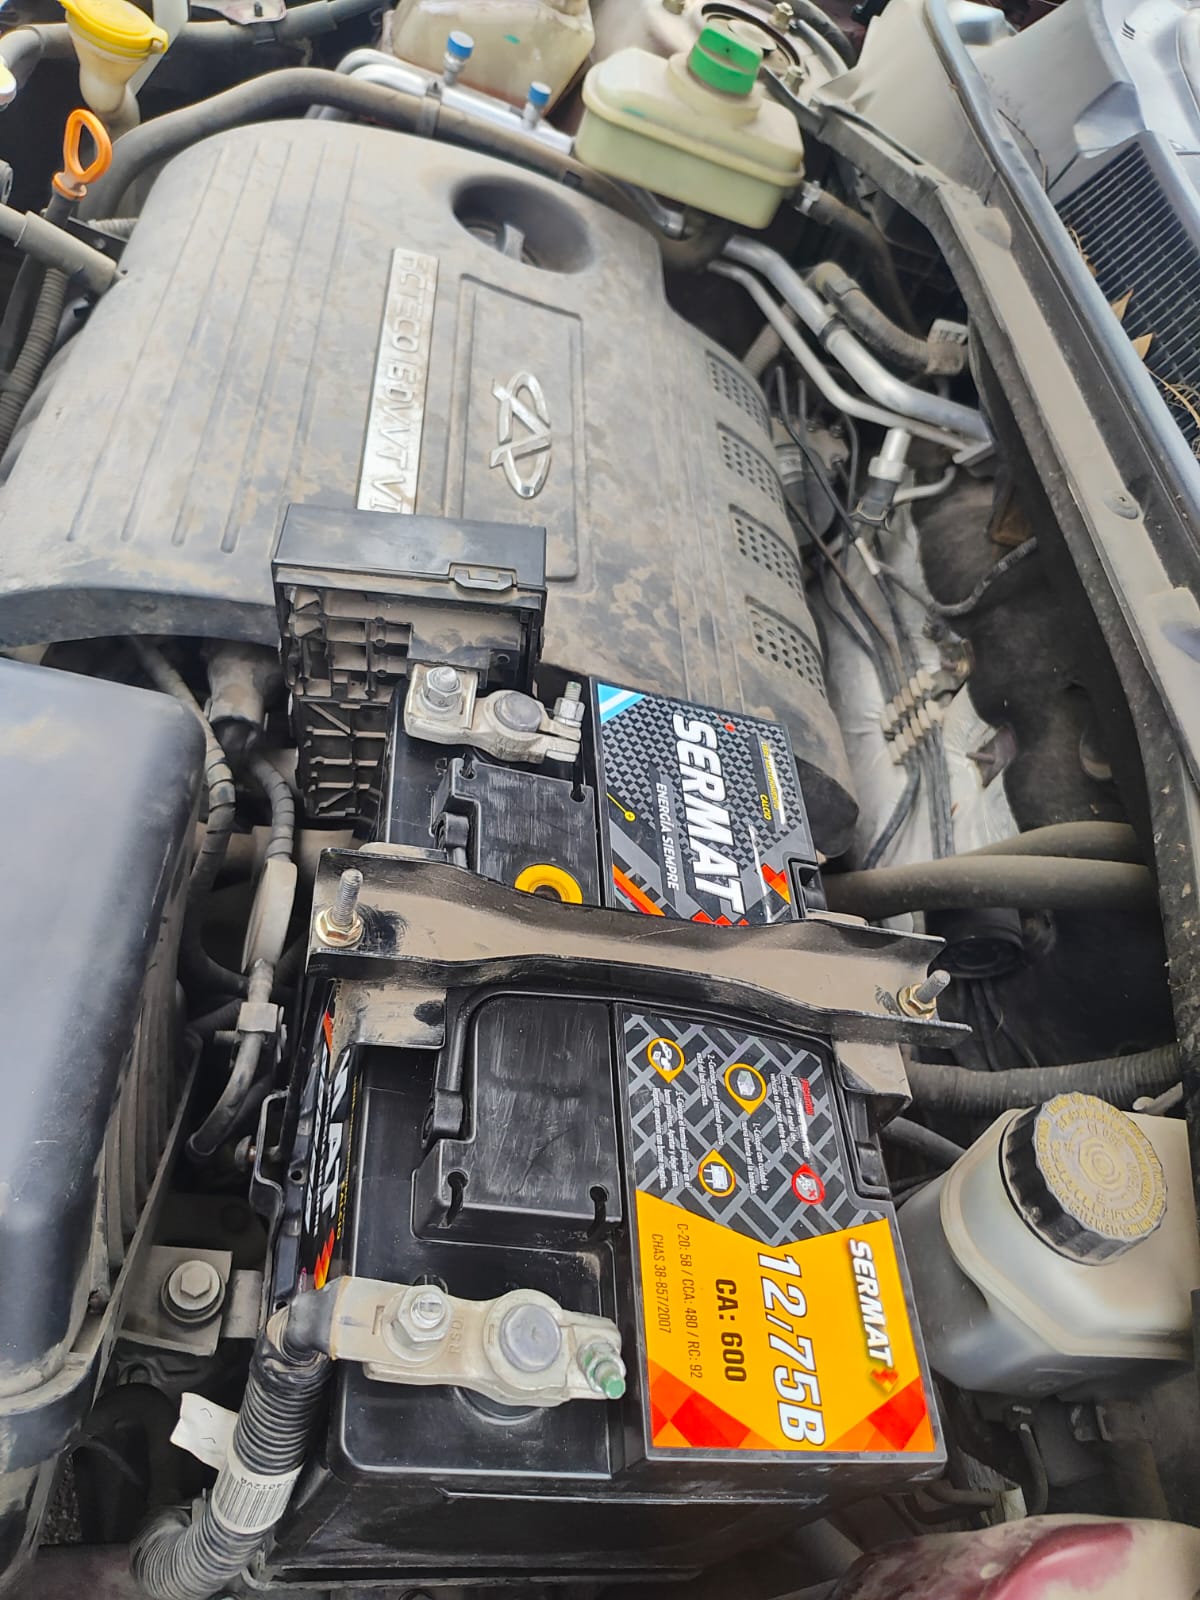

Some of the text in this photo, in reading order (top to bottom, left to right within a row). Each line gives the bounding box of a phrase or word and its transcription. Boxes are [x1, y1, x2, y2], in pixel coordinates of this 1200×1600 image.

[673, 713, 746, 915] SERMAT
[760, 794, 772, 820] CALCIO
[656, 783, 679, 891] ENERGÍA SIEMPRE
[677, 1223, 690, 1251] C-20:
[679, 1253, 692, 1267] 58
[652, 1233, 672, 1334] CHAS 38-857/2007
[681, 1278, 695, 1304] CCA:
[848, 1237, 894, 1368] SERMAT
[684, 1308, 698, 1331] 480
[715, 1278, 747, 1383] CA: 600
[688, 1341, 700, 1361] RC:
[690, 1364, 702, 1378] 92
